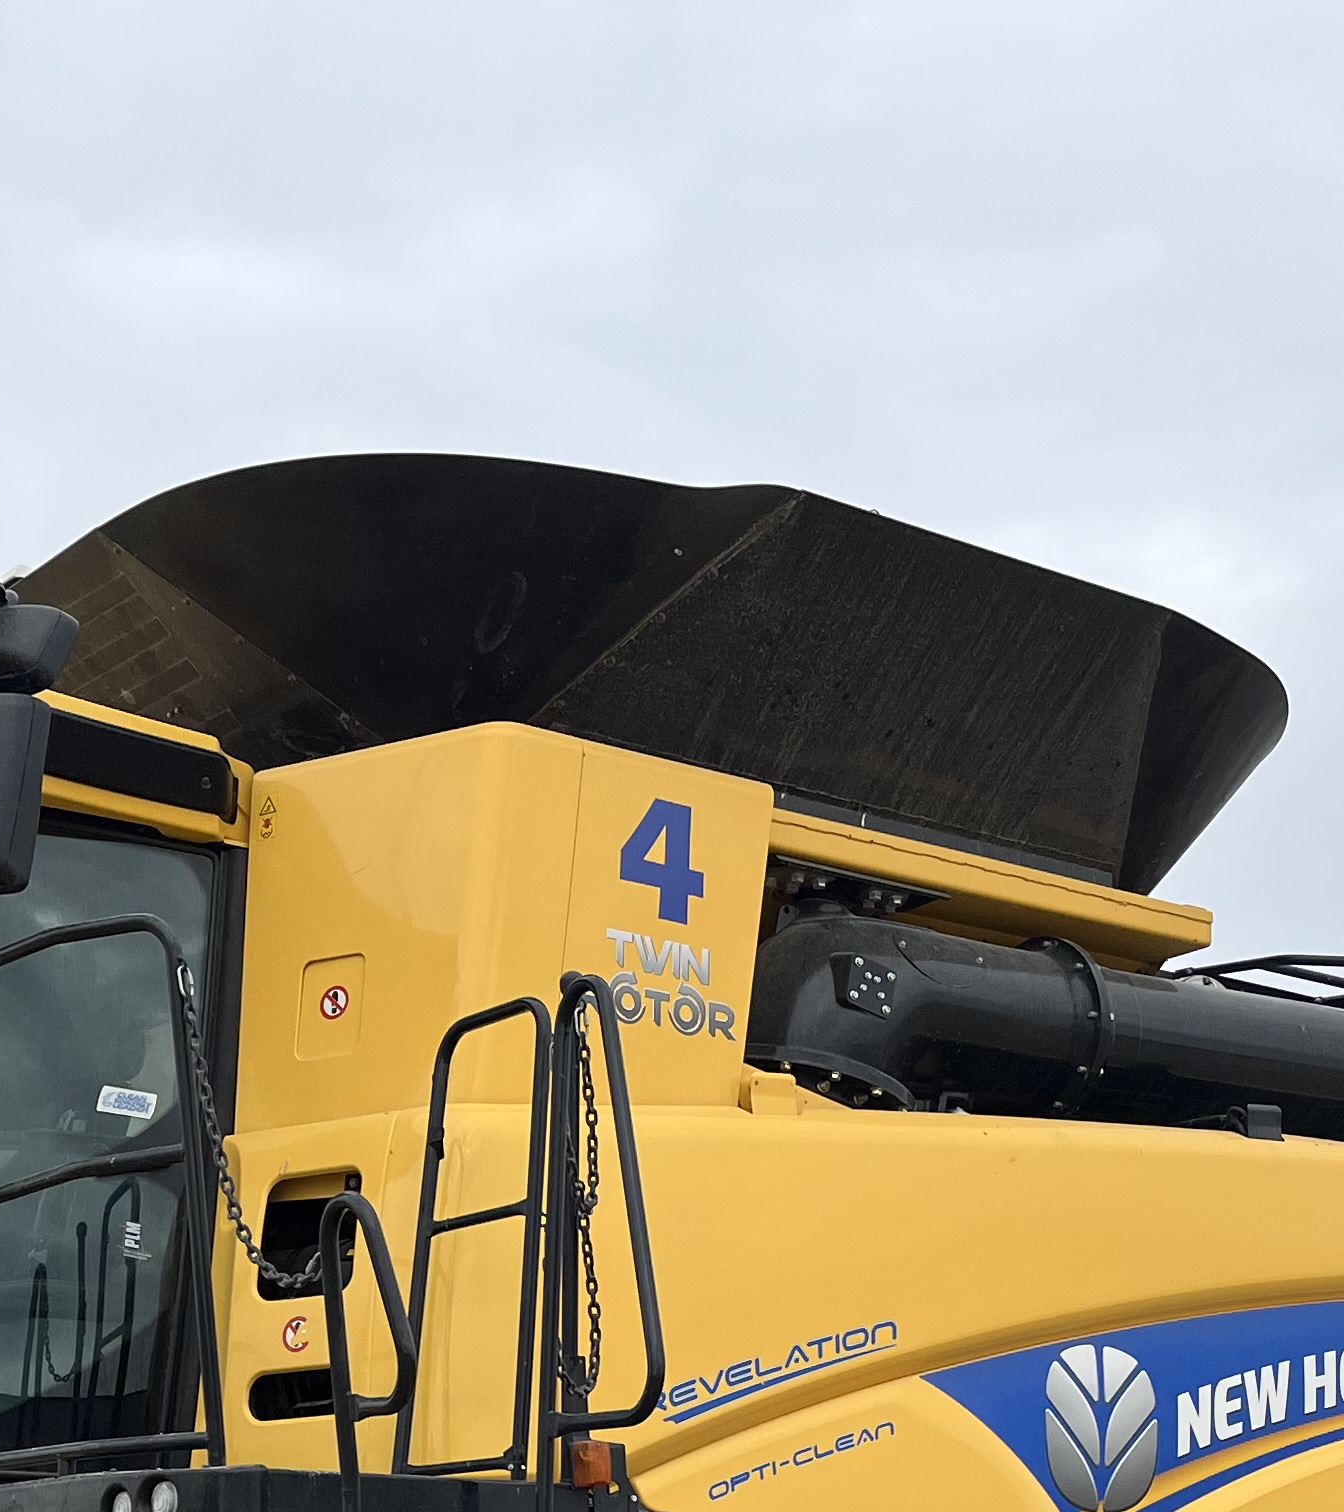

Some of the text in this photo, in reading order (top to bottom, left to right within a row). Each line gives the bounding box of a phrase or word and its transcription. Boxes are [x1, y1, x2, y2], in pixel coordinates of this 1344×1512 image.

[620, 797, 704, 925] 4
[606, 927, 710, 986] TWIN
[580, 971, 737, 1041] OTOR
[1177, 1360, 1290, 1457] NEW
[708, 1421, 896, 1501] OPTI-CLEAN
